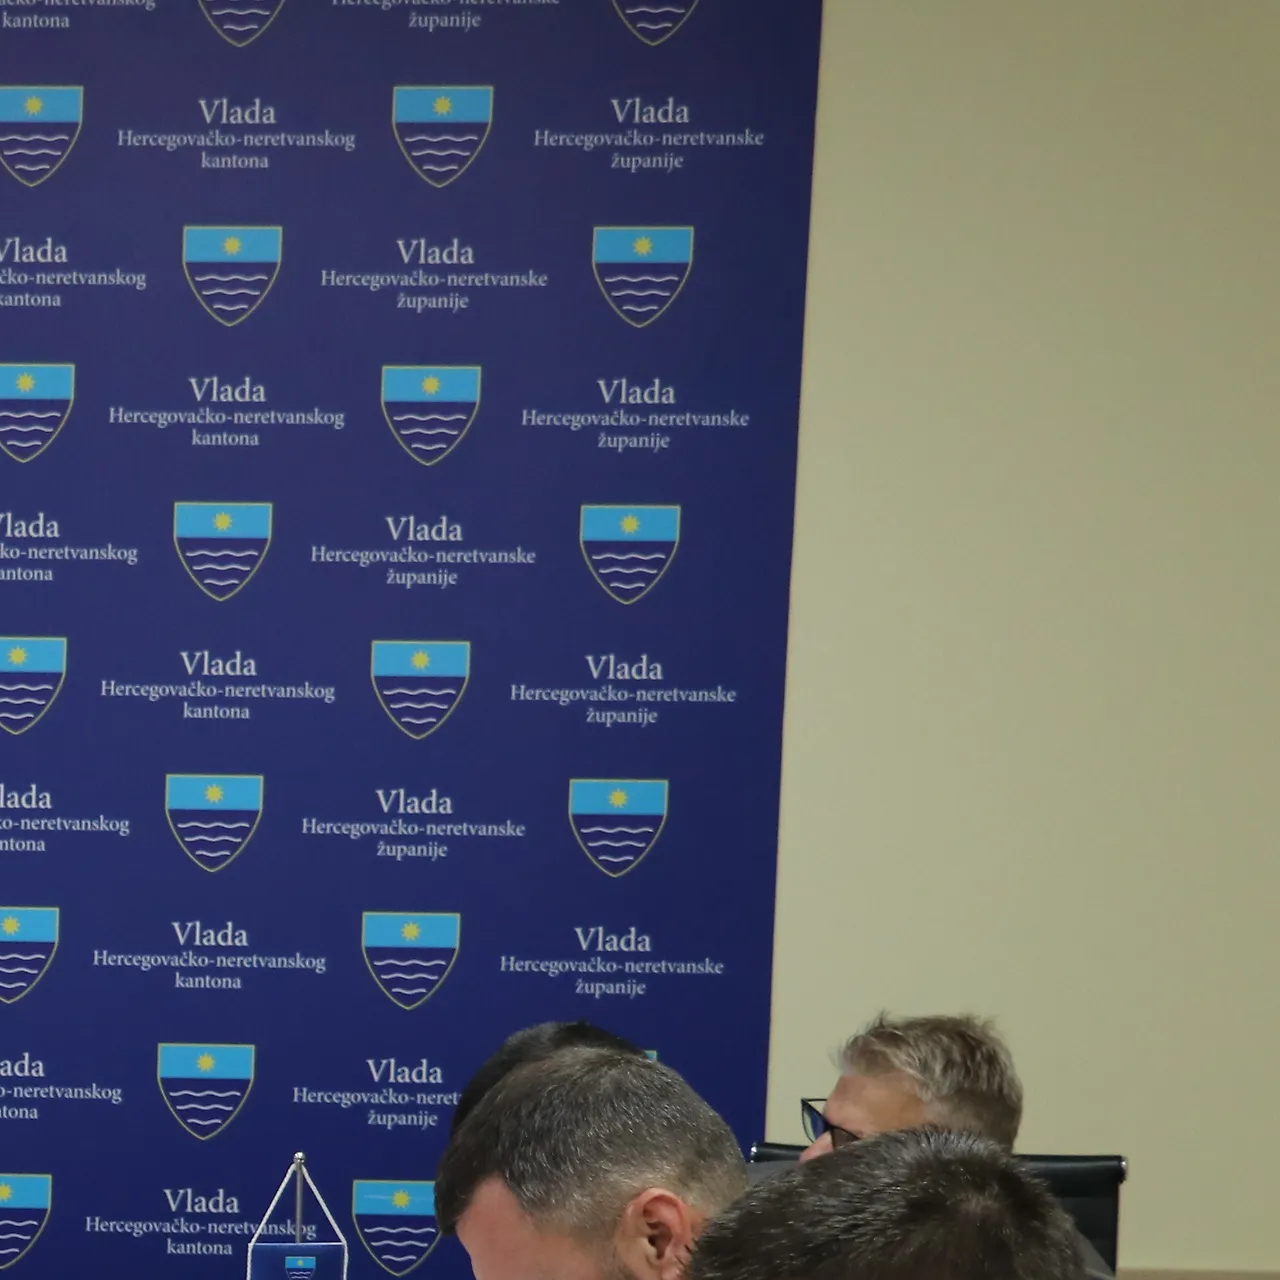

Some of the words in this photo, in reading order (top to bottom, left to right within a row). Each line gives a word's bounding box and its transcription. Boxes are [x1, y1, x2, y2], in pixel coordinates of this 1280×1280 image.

[3, 11, 69, 28] kantona
[409, 12, 481, 32] županije
[198, 98, 276, 124] Vlada
[611, 97, 689, 123] Vlada
[118, 129, 355, 151] Hercegovačko-neretvanskog
[535, 128, 764, 151] Hercegovačko-neretvanske
[202, 151, 269, 168] kantona
[611, 153, 683, 173] županije
[396, 238, 474, 264] Vlada
[321, 269, 547, 291] Hercegovačko-neretvanske
[397, 292, 469, 313] županije
[188, 376, 266, 402] Vlada
[597, 377, 676, 404] Vlada
[109, 406, 344, 429] Hercegovačko-neretvanskog
[522, 408, 749, 431] Hercegovačko-neretvanske
[192, 428, 259, 446] kantona
[598, 432, 670, 453] županije
[385, 515, 463, 541] Vlada
[311, 545, 536, 567] Hercegovačko-neretvanske
[387, 568, 458, 589] županije
[180, 650, 257, 676] Vlada
[585, 653, 663, 680] Vlada
[101, 680, 335, 703] Hercegovačko-neretvanskog
[511, 684, 736, 706] Hercegovačko-neretvanske
[183, 701, 250, 719] kantona
[586, 708, 658, 728] županije
[375, 788, 453, 814] Vlada
[302, 818, 525, 839] Hercegovačko-neretvanske
[377, 840, 448, 861] županije
[172, 920, 248, 946] Vlada
[574, 926, 651, 952] Vlada
[93, 950, 326, 974] Hercegovačko-neretvanskog
[500, 956, 724, 977] Hercegovačko-neretvanske
[175, 971, 241, 989] kantona
[576, 978, 646, 999] županije
[366, 1058, 443, 1084] Vlada
[293, 1087, 462, 1108] Hercegovačko-neret
[368, 1109, 438, 1130] županije
[163, 1188, 240, 1213] Vlada
[167, 1238, 232, 1255] kantona
